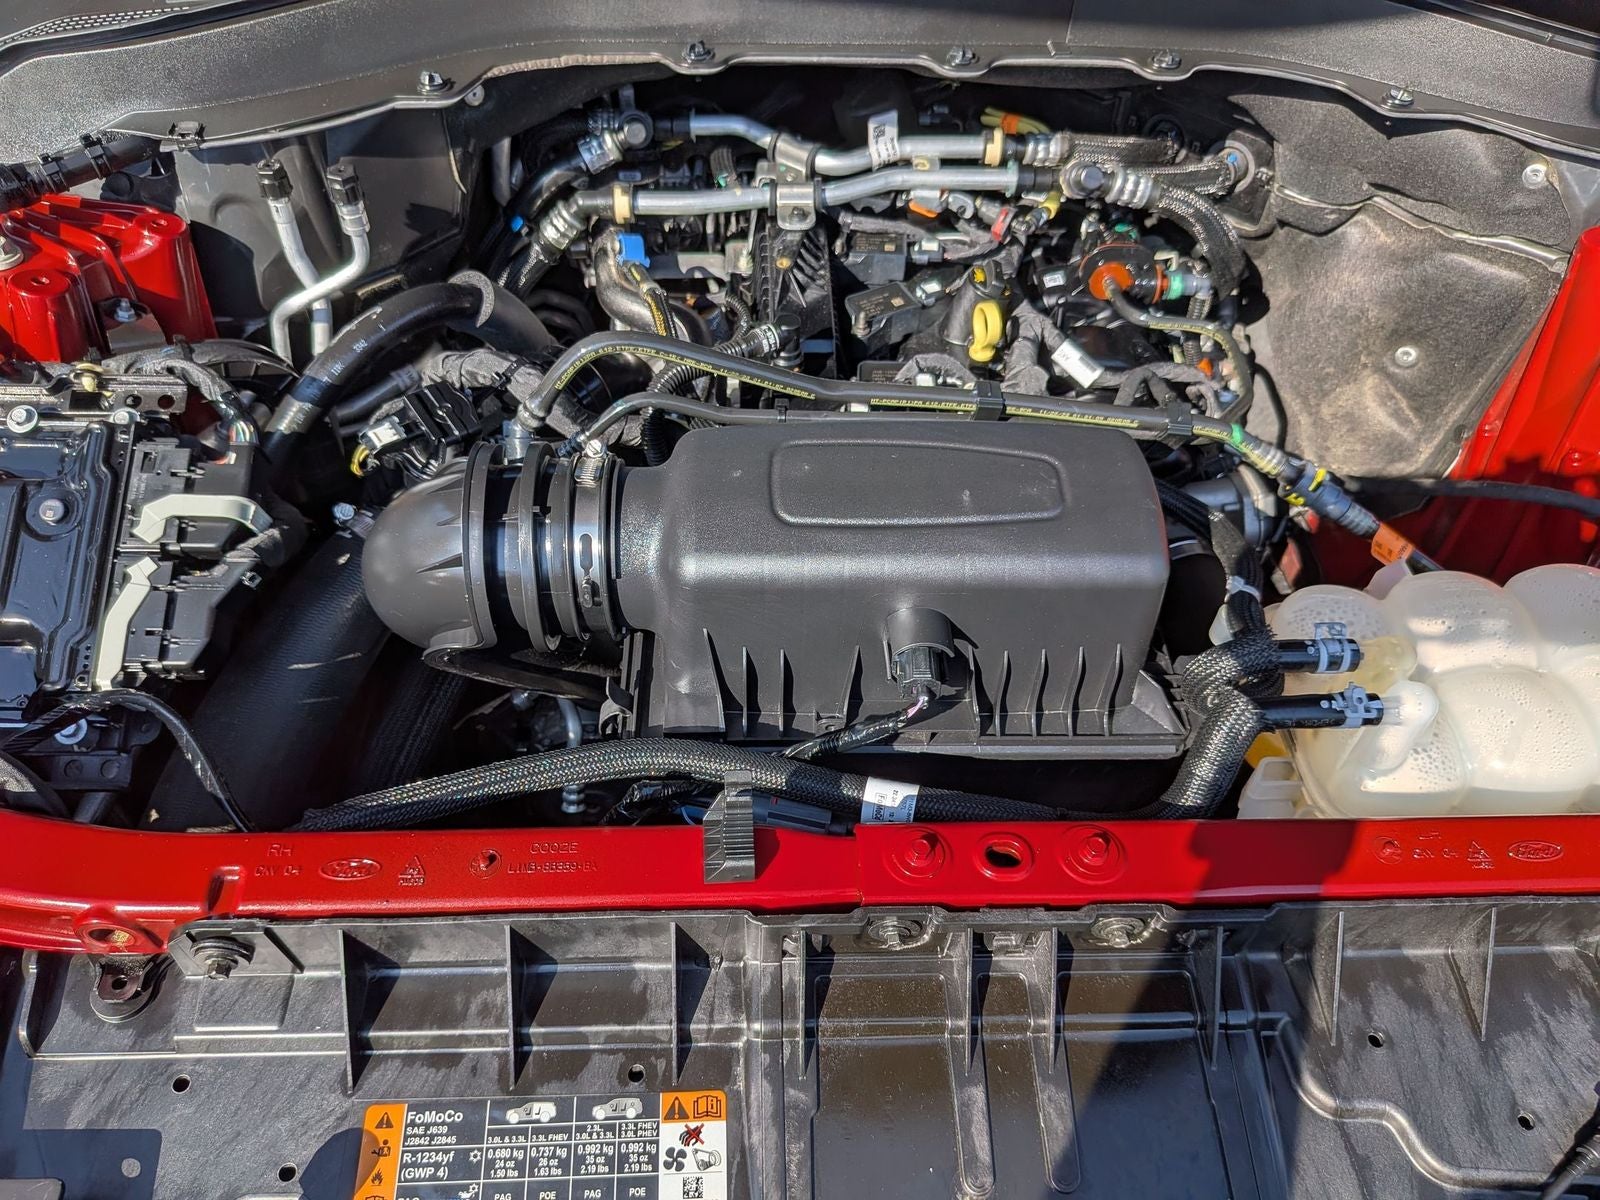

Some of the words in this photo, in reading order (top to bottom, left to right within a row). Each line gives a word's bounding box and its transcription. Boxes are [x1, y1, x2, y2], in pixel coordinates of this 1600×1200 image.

[407, 1110, 463, 1123] FoMoCo
[405, 1137, 429, 1145] J2842
[531, 1147, 554, 1157] 0.737
[556, 1146, 567, 1158] kg
[578, 1144, 600, 1154] 0.992
[603, 1144, 613, 1155] kg
[621, 1143, 644, 1153] 0.992
[646, 1142, 656, 1153] kg
[403, 1151, 455, 1165] R-1234yf
[488, 1148, 511, 1159] 0.680
[513, 1148, 524, 1160] kg
[539, 1158, 548, 1166] 26
[581, 1165, 596, 1174] 2.19
[598, 1164, 609, 1173] lbs
[624, 1164, 639, 1172] 2.19
[401, 1167, 434, 1181] (GWP
[437, 1167, 448, 1180] 4)
[539, 1192, 556, 1200] POE
[584, 1190, 601, 1198] PAG
[629, 1188, 646, 1197] POE
